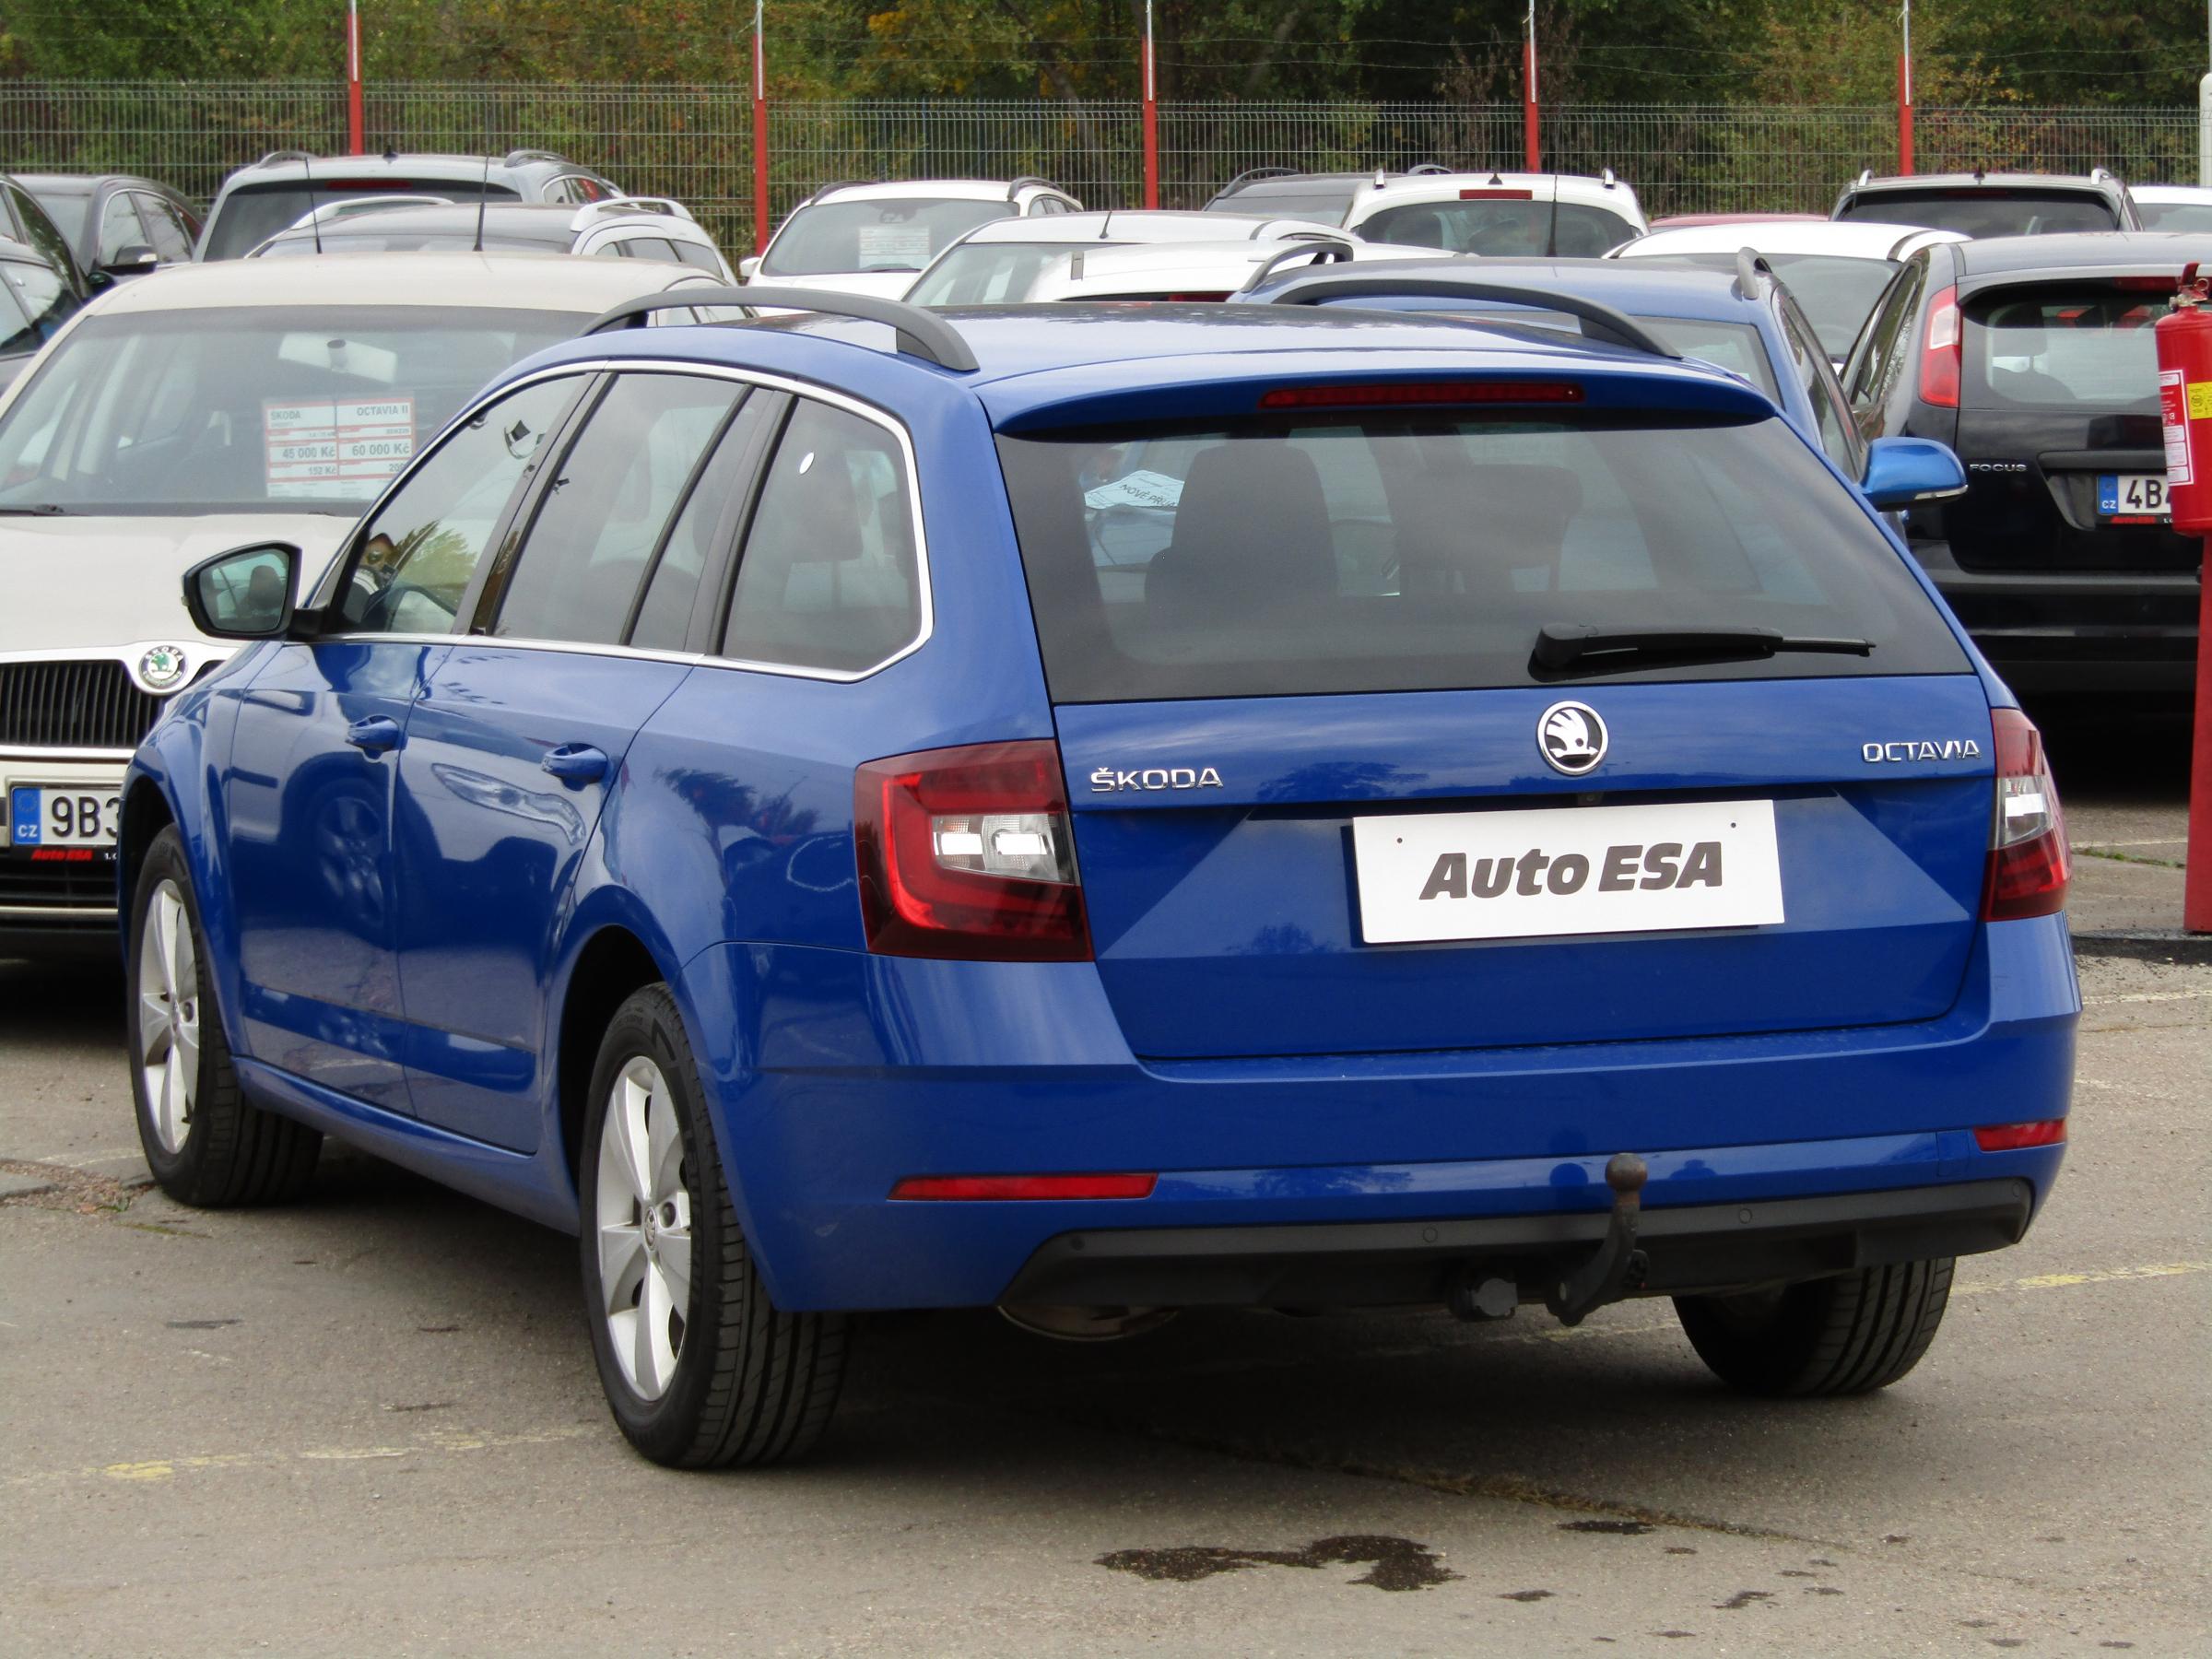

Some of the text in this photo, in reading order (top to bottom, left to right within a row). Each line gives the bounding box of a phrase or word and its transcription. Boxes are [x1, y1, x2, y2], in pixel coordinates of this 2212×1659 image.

[357, 405, 408, 416] OCTAVIA II
[297, 447, 317, 458] 000
[352, 442, 410, 456] 60 000 Kč
[1969, 464, 2027, 472] FOCUS
[2101, 500, 2116, 509] CZ
[1862, 739, 1982, 762] OCTAVIA
[1090, 767, 1224, 793] ŠKODA
[18, 824, 38, 838] CZ
[31, 849, 65, 861] Auto
[1418, 841, 1723, 900] Auto ESA
